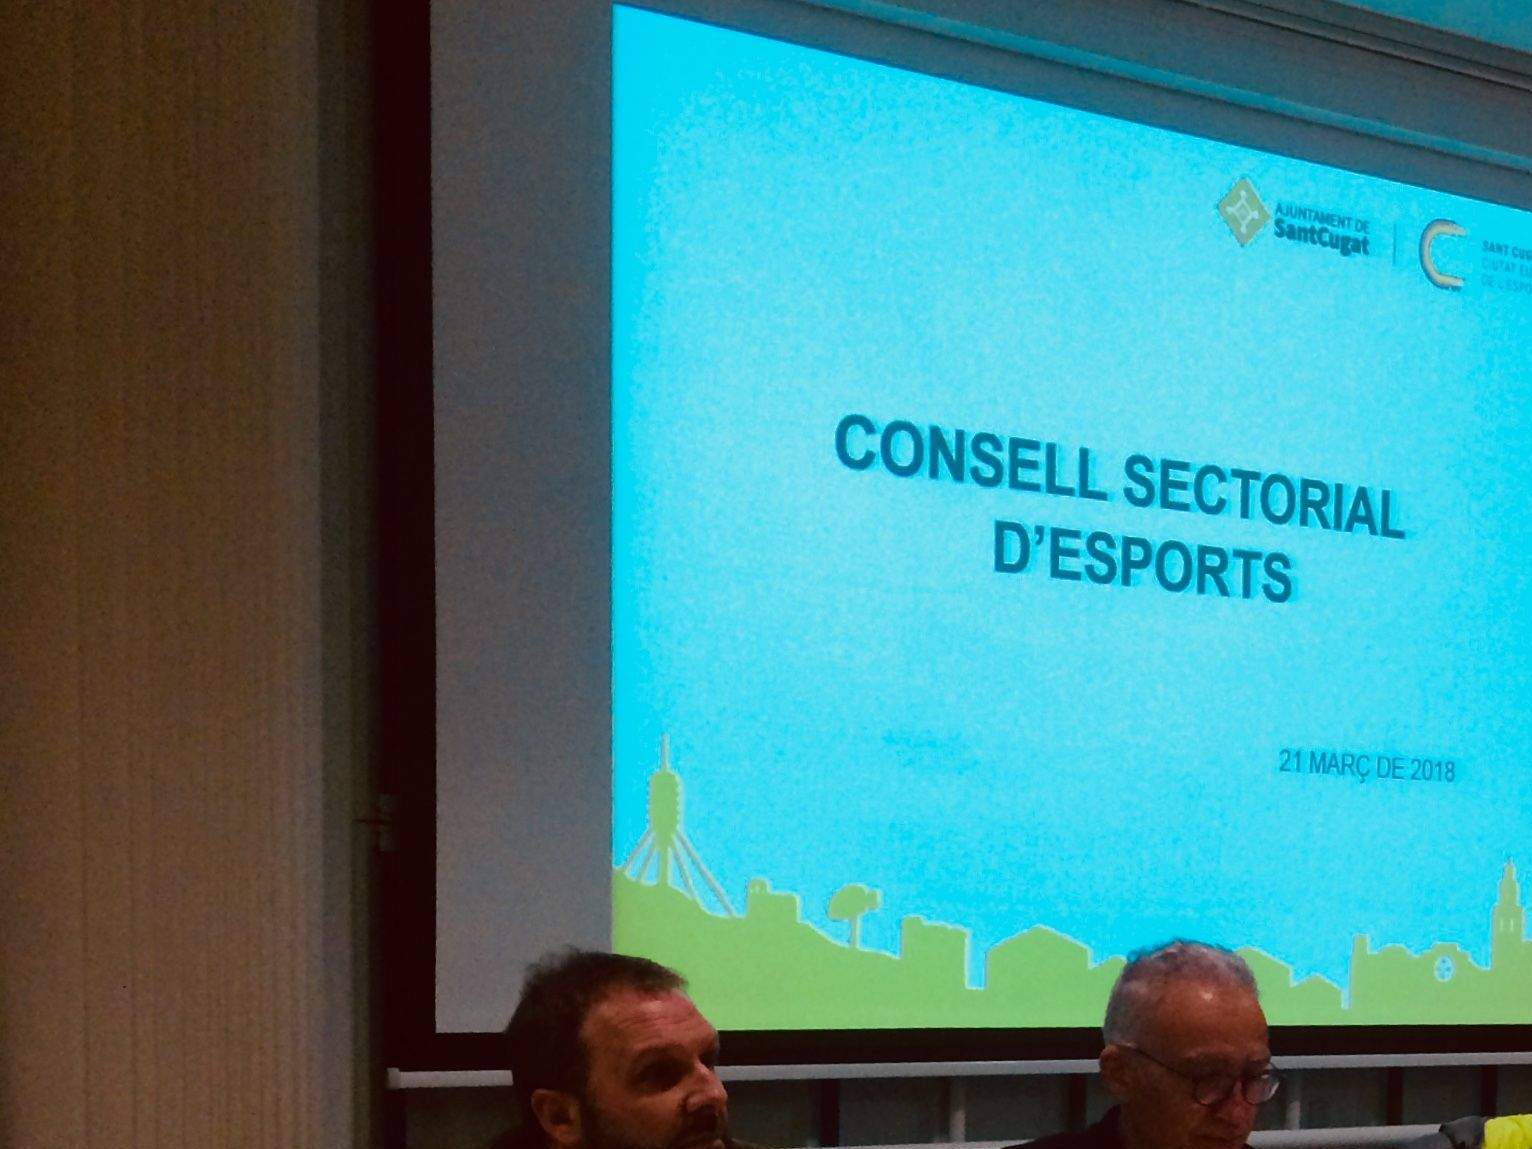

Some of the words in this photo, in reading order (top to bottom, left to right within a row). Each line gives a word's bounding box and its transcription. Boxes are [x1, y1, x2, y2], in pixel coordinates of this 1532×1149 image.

[1274, 217, 1370, 257] SantCugat
[1275, 203, 1352, 229] AJUNTAMENT
[1354, 219, 1370, 235] DE
[1482, 239, 1509, 256] SANT
[834, 413, 1108, 502] CONSELL
[1122, 453, 1407, 541] SECTORIAL
[993, 519, 1293, 605] D'ESPORTS
[1278, 748, 1302, 773] 21
[1308, 750, 1371, 784] MARÇ
[1376, 755, 1405, 780] DE
[1409, 757, 1457, 783] 2018
